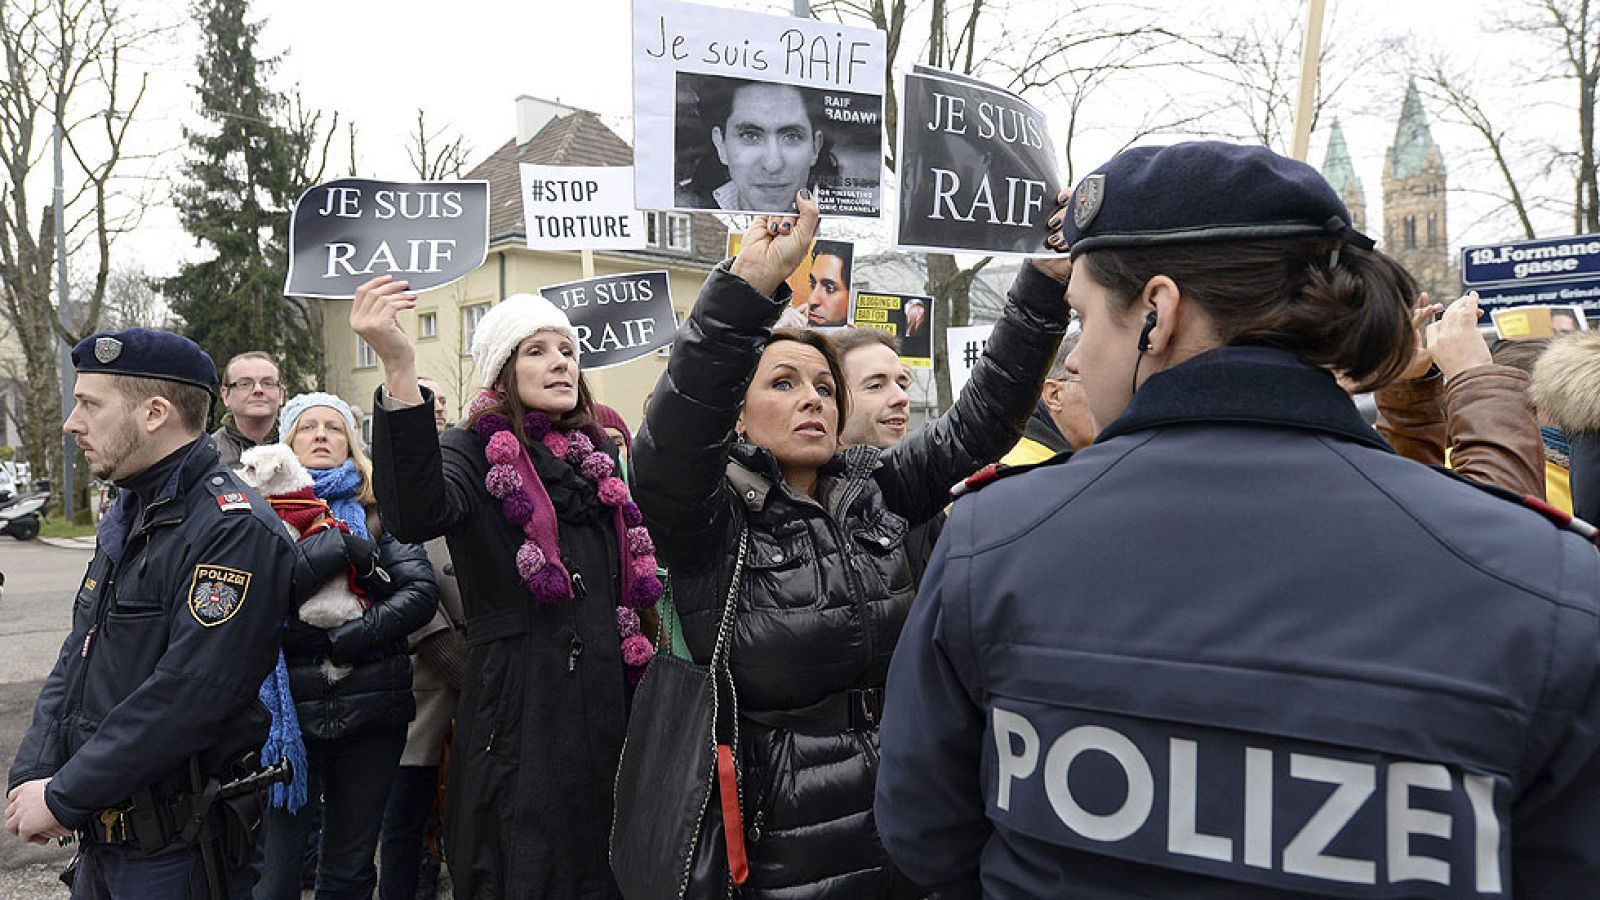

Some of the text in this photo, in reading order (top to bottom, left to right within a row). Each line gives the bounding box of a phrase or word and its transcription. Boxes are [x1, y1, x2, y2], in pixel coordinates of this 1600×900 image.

[646, 15, 688, 61] Je
[702, 39, 768, 71] suis
[824, 95, 851, 108] RAIF
[825, 107, 877, 124] BADAWI
[927, 93, 1044, 150] JE SUIS
[318, 187, 463, 219] JE SUIS
[532, 179, 599, 202] #STOP
[927, 167, 1047, 228] RAIF
[534, 214, 631, 238] TORTURE
[323, 238, 456, 279] RAIF
[1513, 258, 1579, 278] gasse
[560, 279, 654, 310] JE SUIS
[577, 318, 656, 354] RAIF
[199, 569, 246, 586] POLIZEI
[992, 706, 1503, 894] POLIZEI
